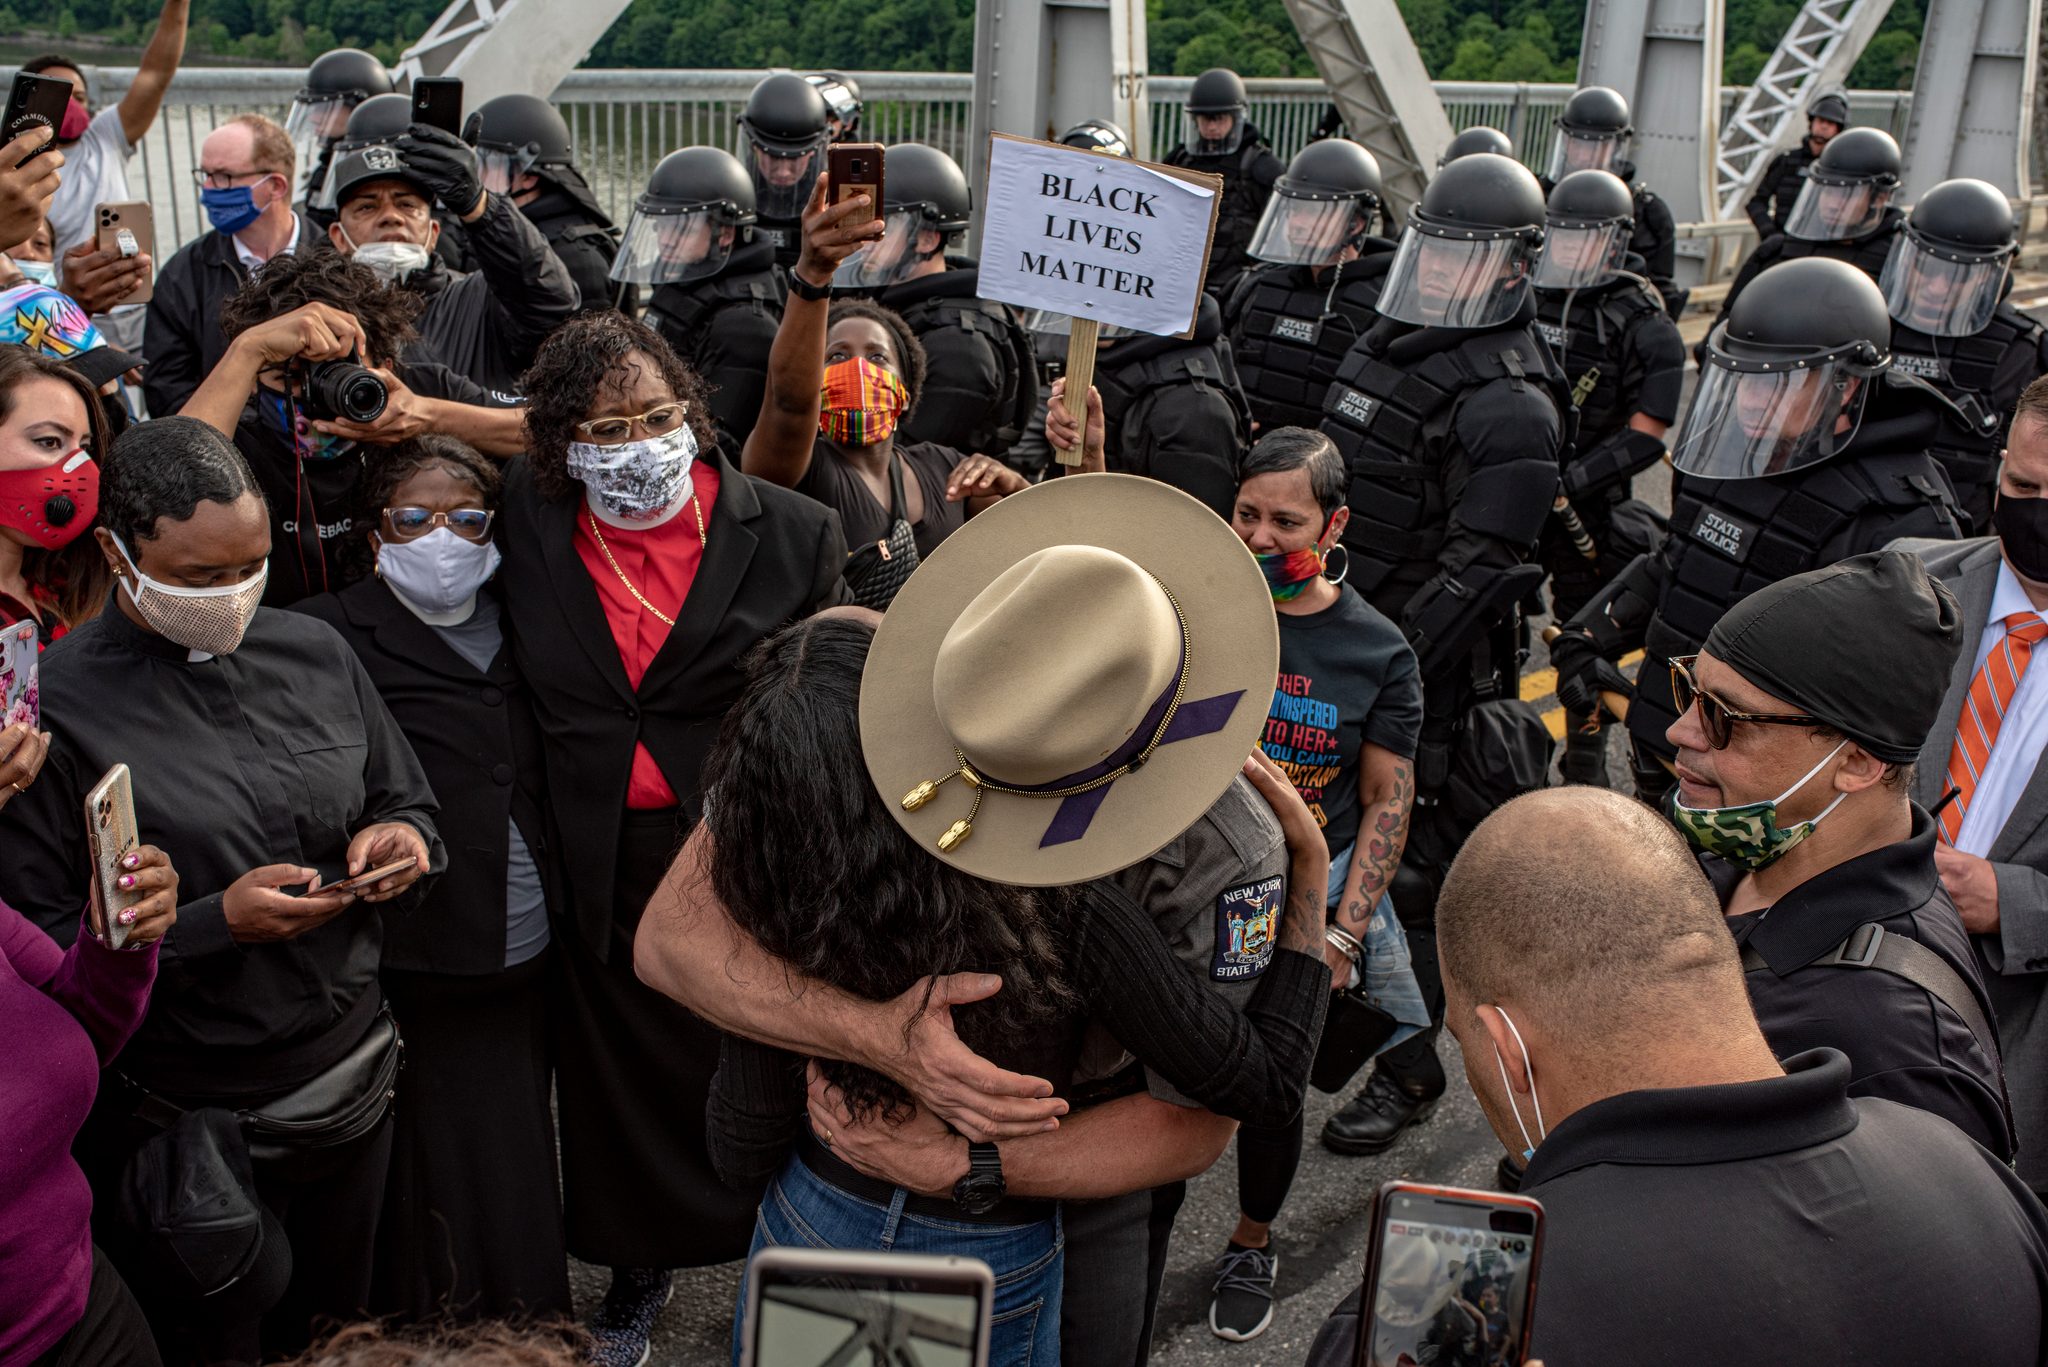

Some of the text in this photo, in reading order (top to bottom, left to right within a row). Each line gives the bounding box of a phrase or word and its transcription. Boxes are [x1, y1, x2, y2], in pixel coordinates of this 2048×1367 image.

[11, 113, 53, 129] COMMUNIT
[1039, 173, 1159, 218] BLACK
[1043, 214, 1142, 254] LIVES
[1019, 251, 1155, 298] MATTER
[1276, 326, 1312, 342] POLICE
[1281, 319, 1313, 334] STATE
[1897, 355, 1939, 369] STATE
[1337, 400, 1368, 422] POLICE
[1345, 391, 1372, 411] STATE
[1705, 513, 1743, 541] STATE
[1696, 523, 1740, 556] POLICE
[1277, 672, 1312, 696] THEY
[1266, 719, 1328, 753] TO HER
[1262, 743, 1341, 767] YOU CAN'T
[1223, 878, 1281, 904] NEW YORK
[1216, 963, 1251, 977] STATE
